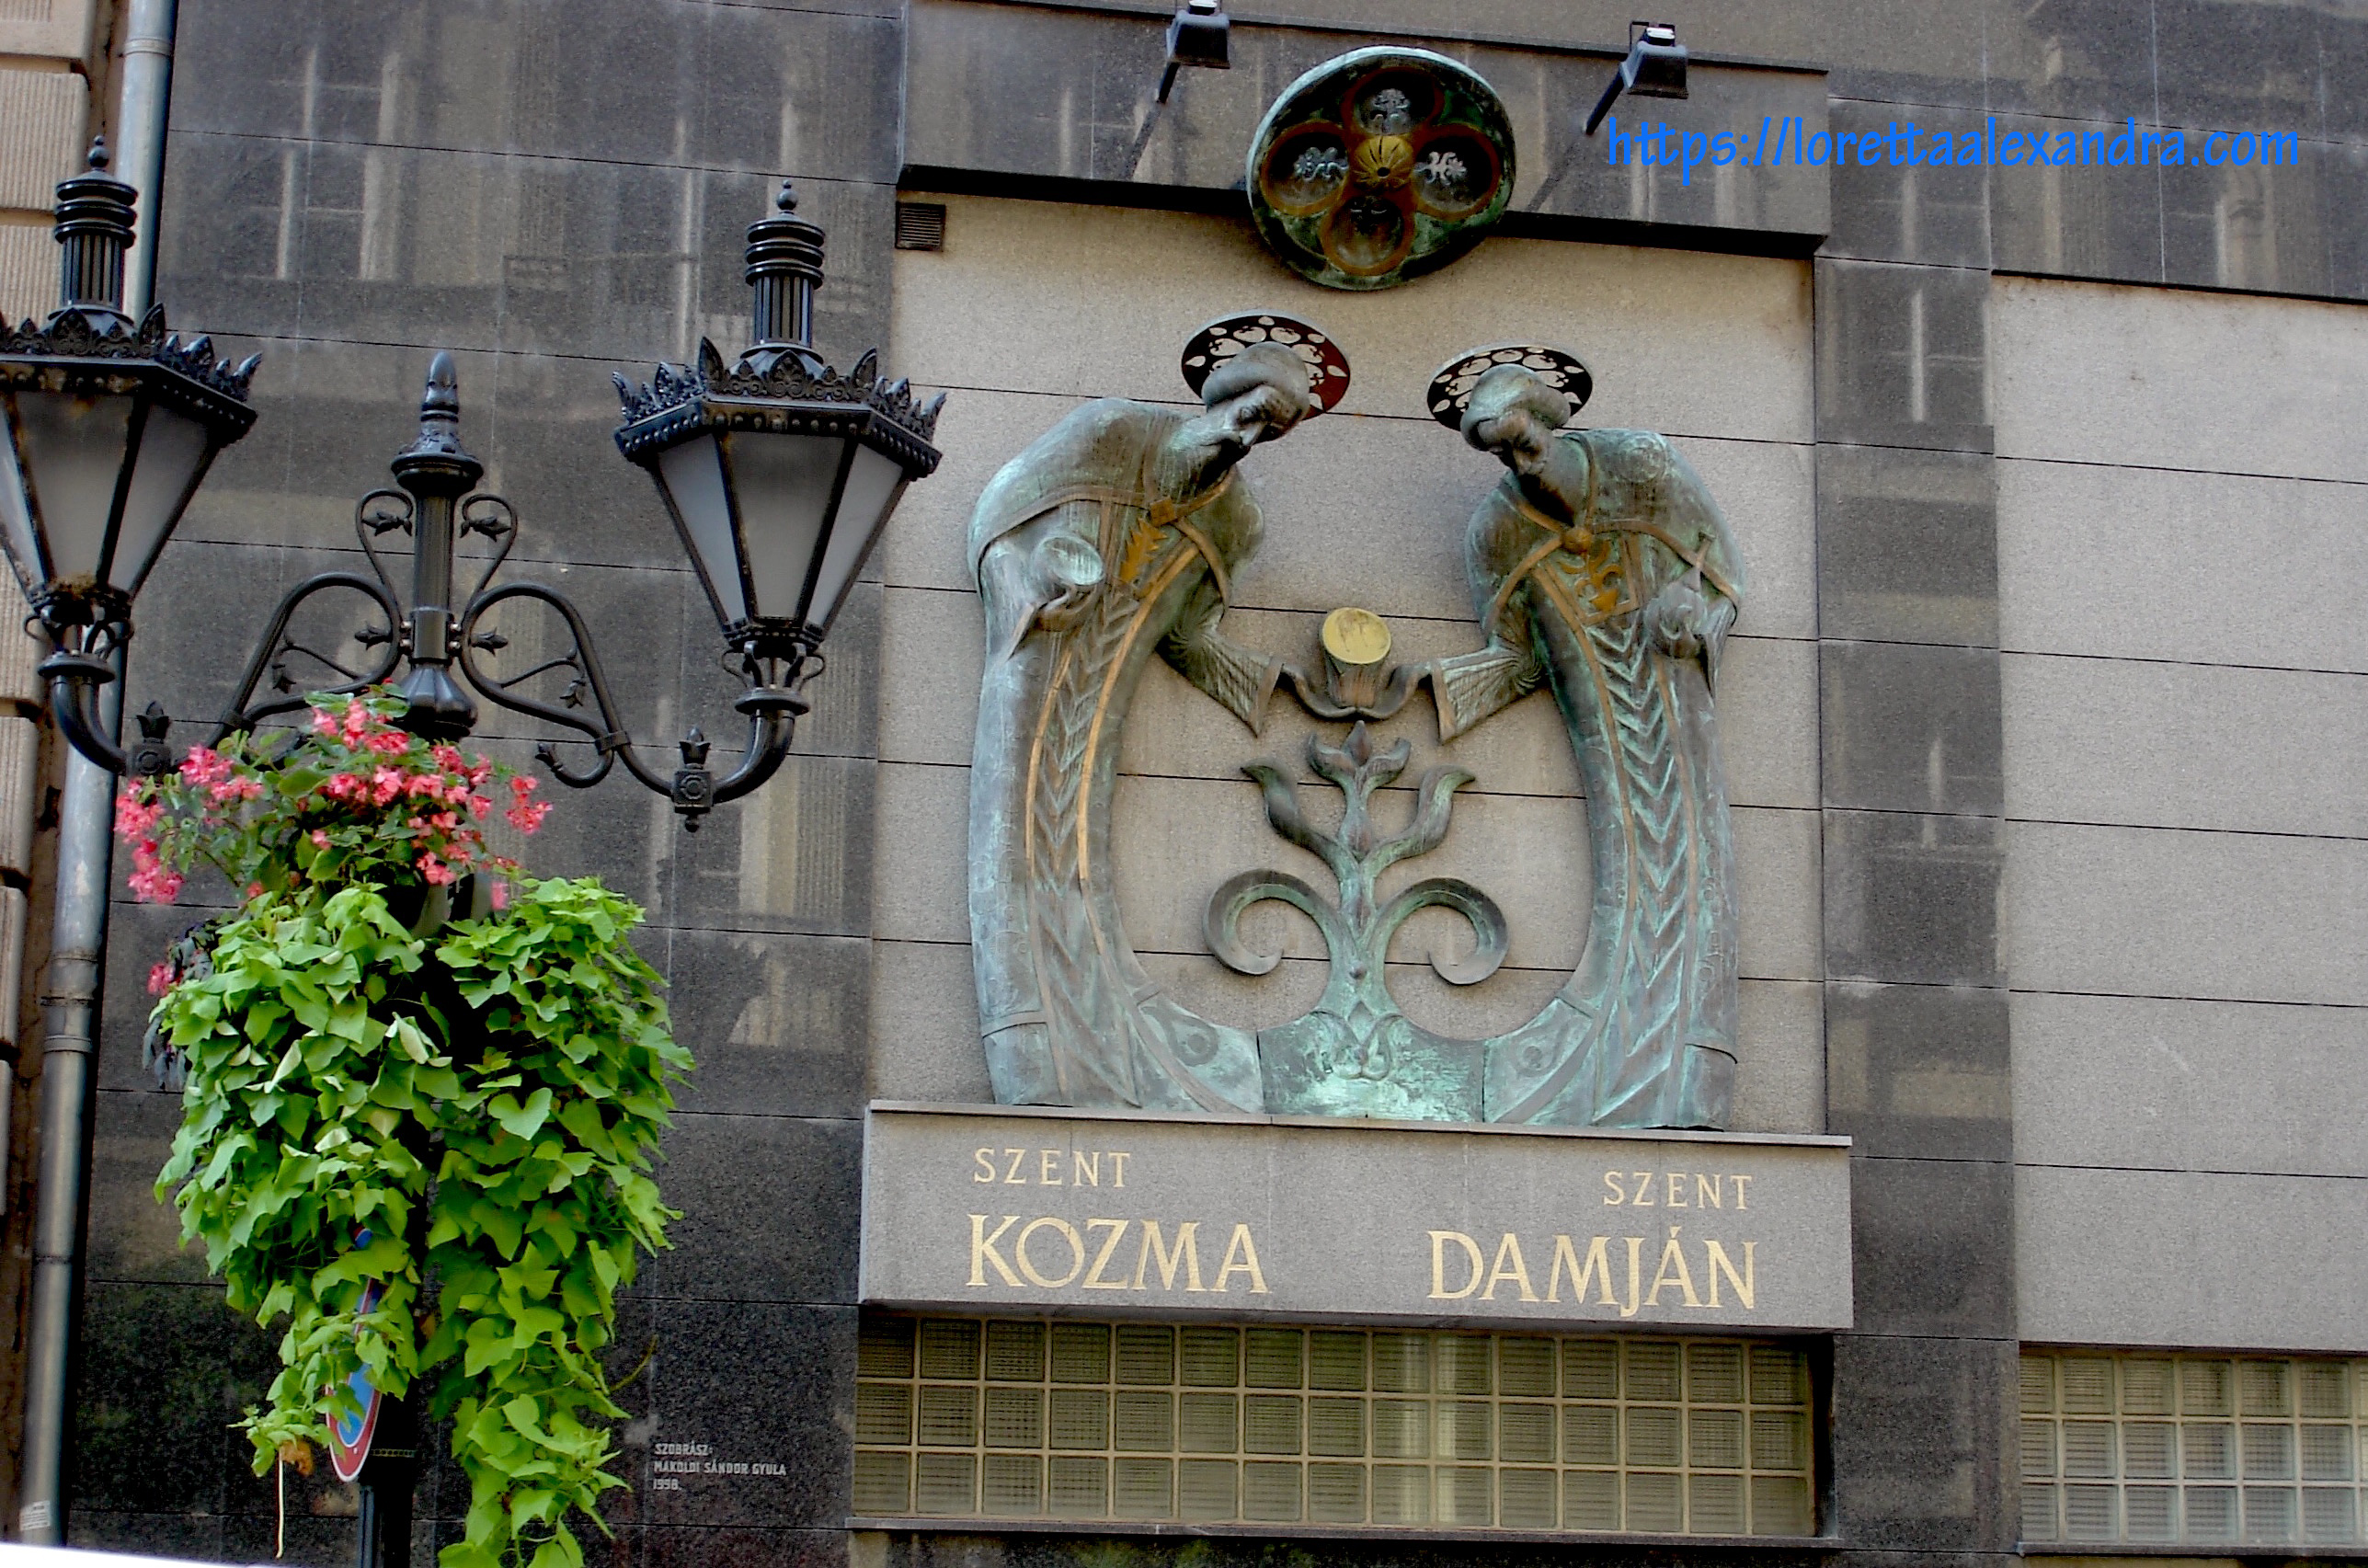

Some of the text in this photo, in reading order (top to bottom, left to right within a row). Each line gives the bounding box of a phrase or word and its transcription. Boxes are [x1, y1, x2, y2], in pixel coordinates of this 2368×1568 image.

[973, 1147, 1131, 1188] SZENT
[1603, 1170, 1752, 1210] SZENT
[966, 1213, 1270, 1293] KOZMA
[1426, 1225, 1757, 1318] DAMJÁN
[704, 1459, 749, 1475] SÁNDOR
[752, 1463, 787, 1476] GYULA
